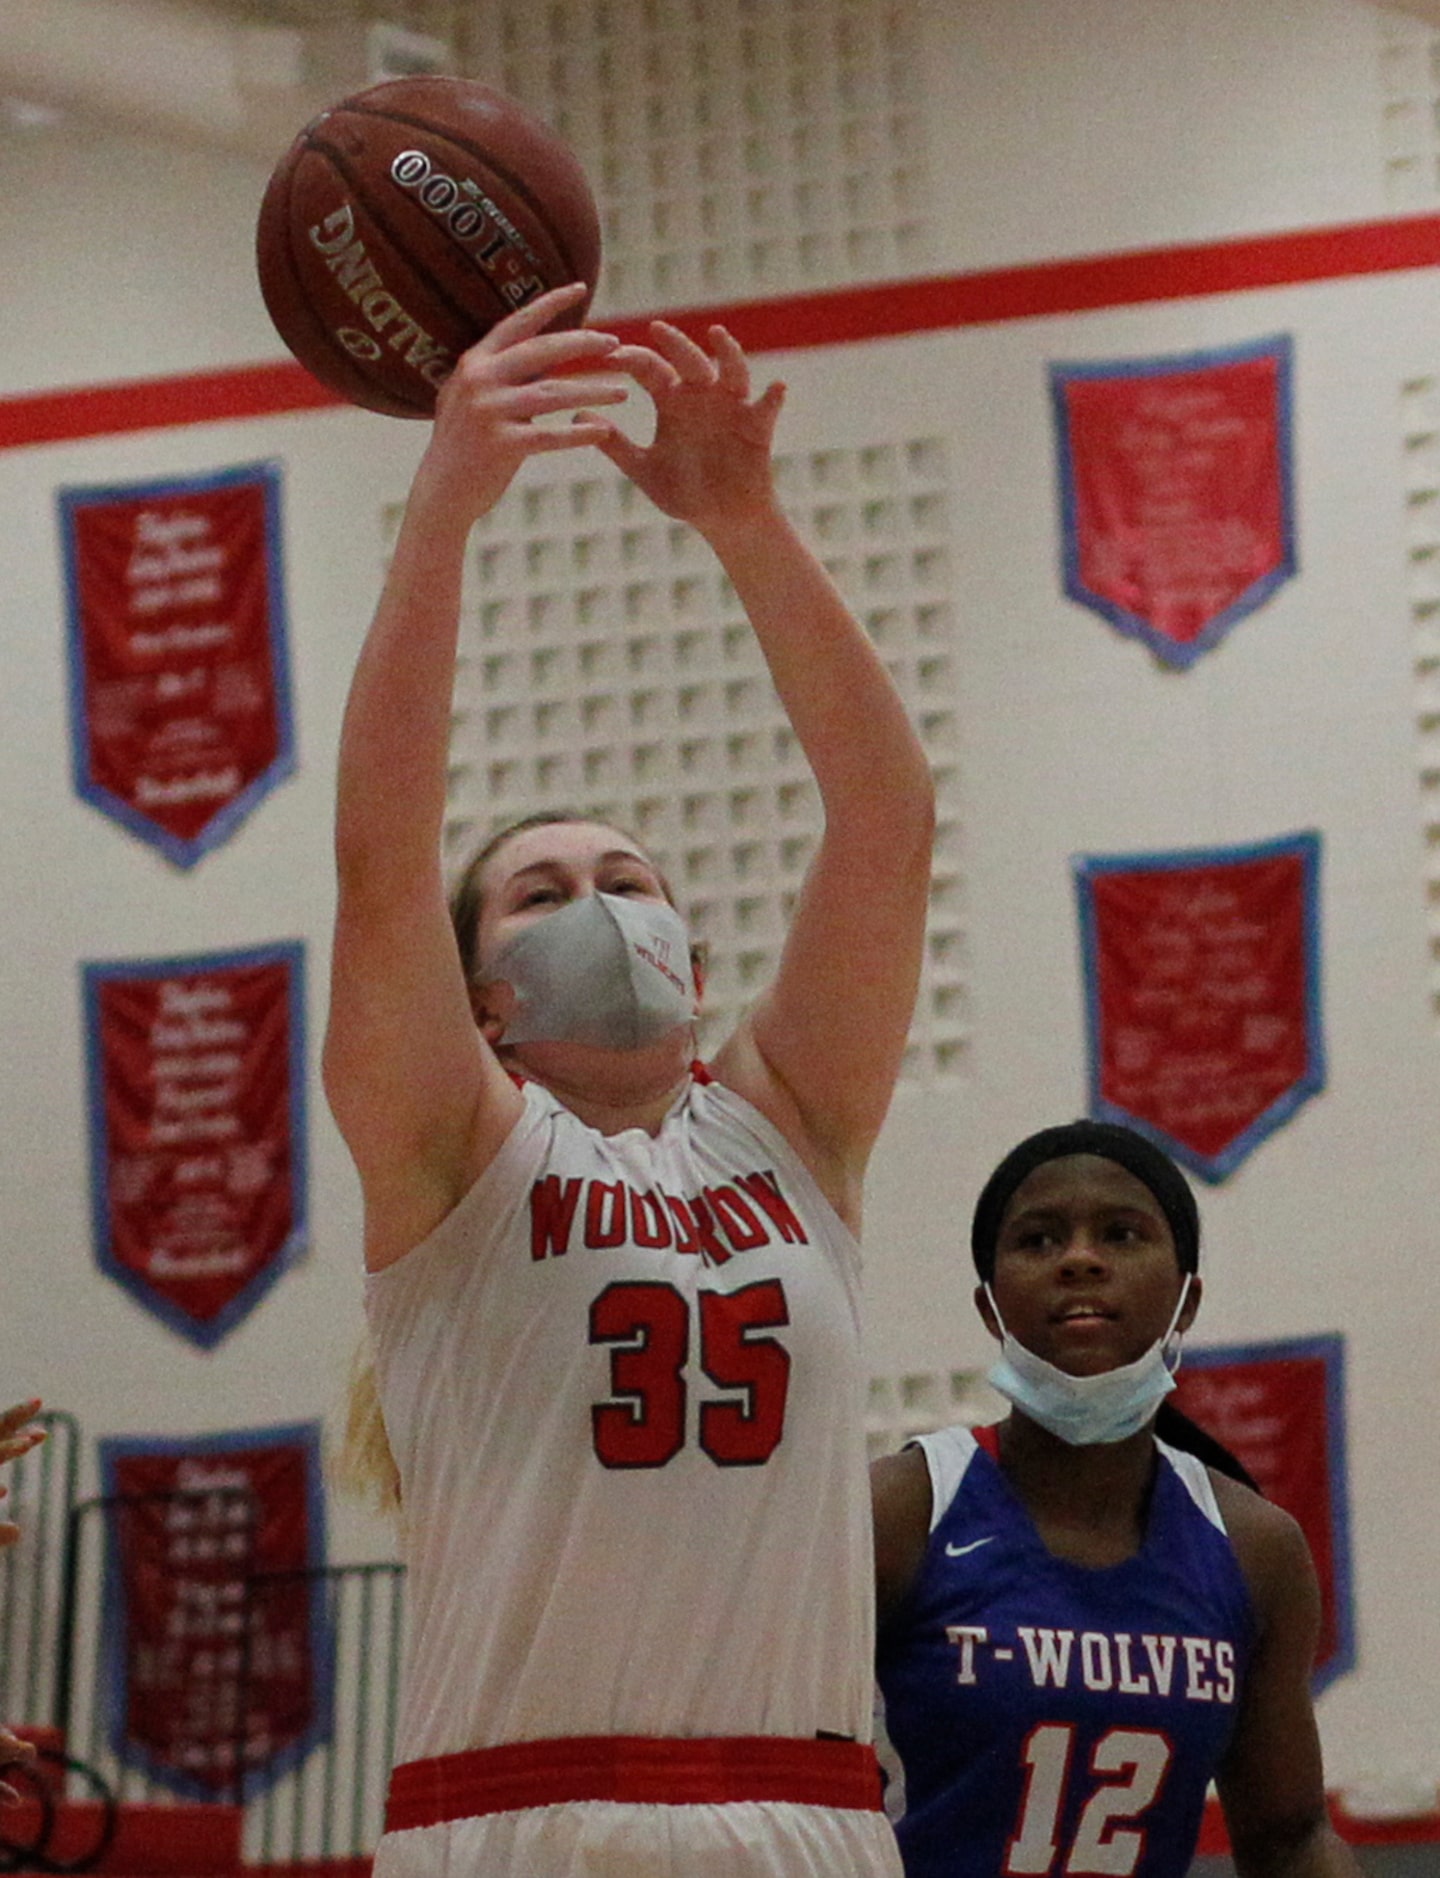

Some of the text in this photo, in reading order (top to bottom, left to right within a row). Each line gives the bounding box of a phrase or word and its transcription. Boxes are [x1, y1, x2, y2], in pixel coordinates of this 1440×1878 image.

[309, 204, 455, 390] PALDING
[391, 150, 544, 309] F-1000
[530, 1170, 809, 1268] WOODROW
[588, 1278, 791, 1469] 35
[945, 1625, 1236, 1703] T-WOLVES
[1002, 1721, 1174, 1877] 12
